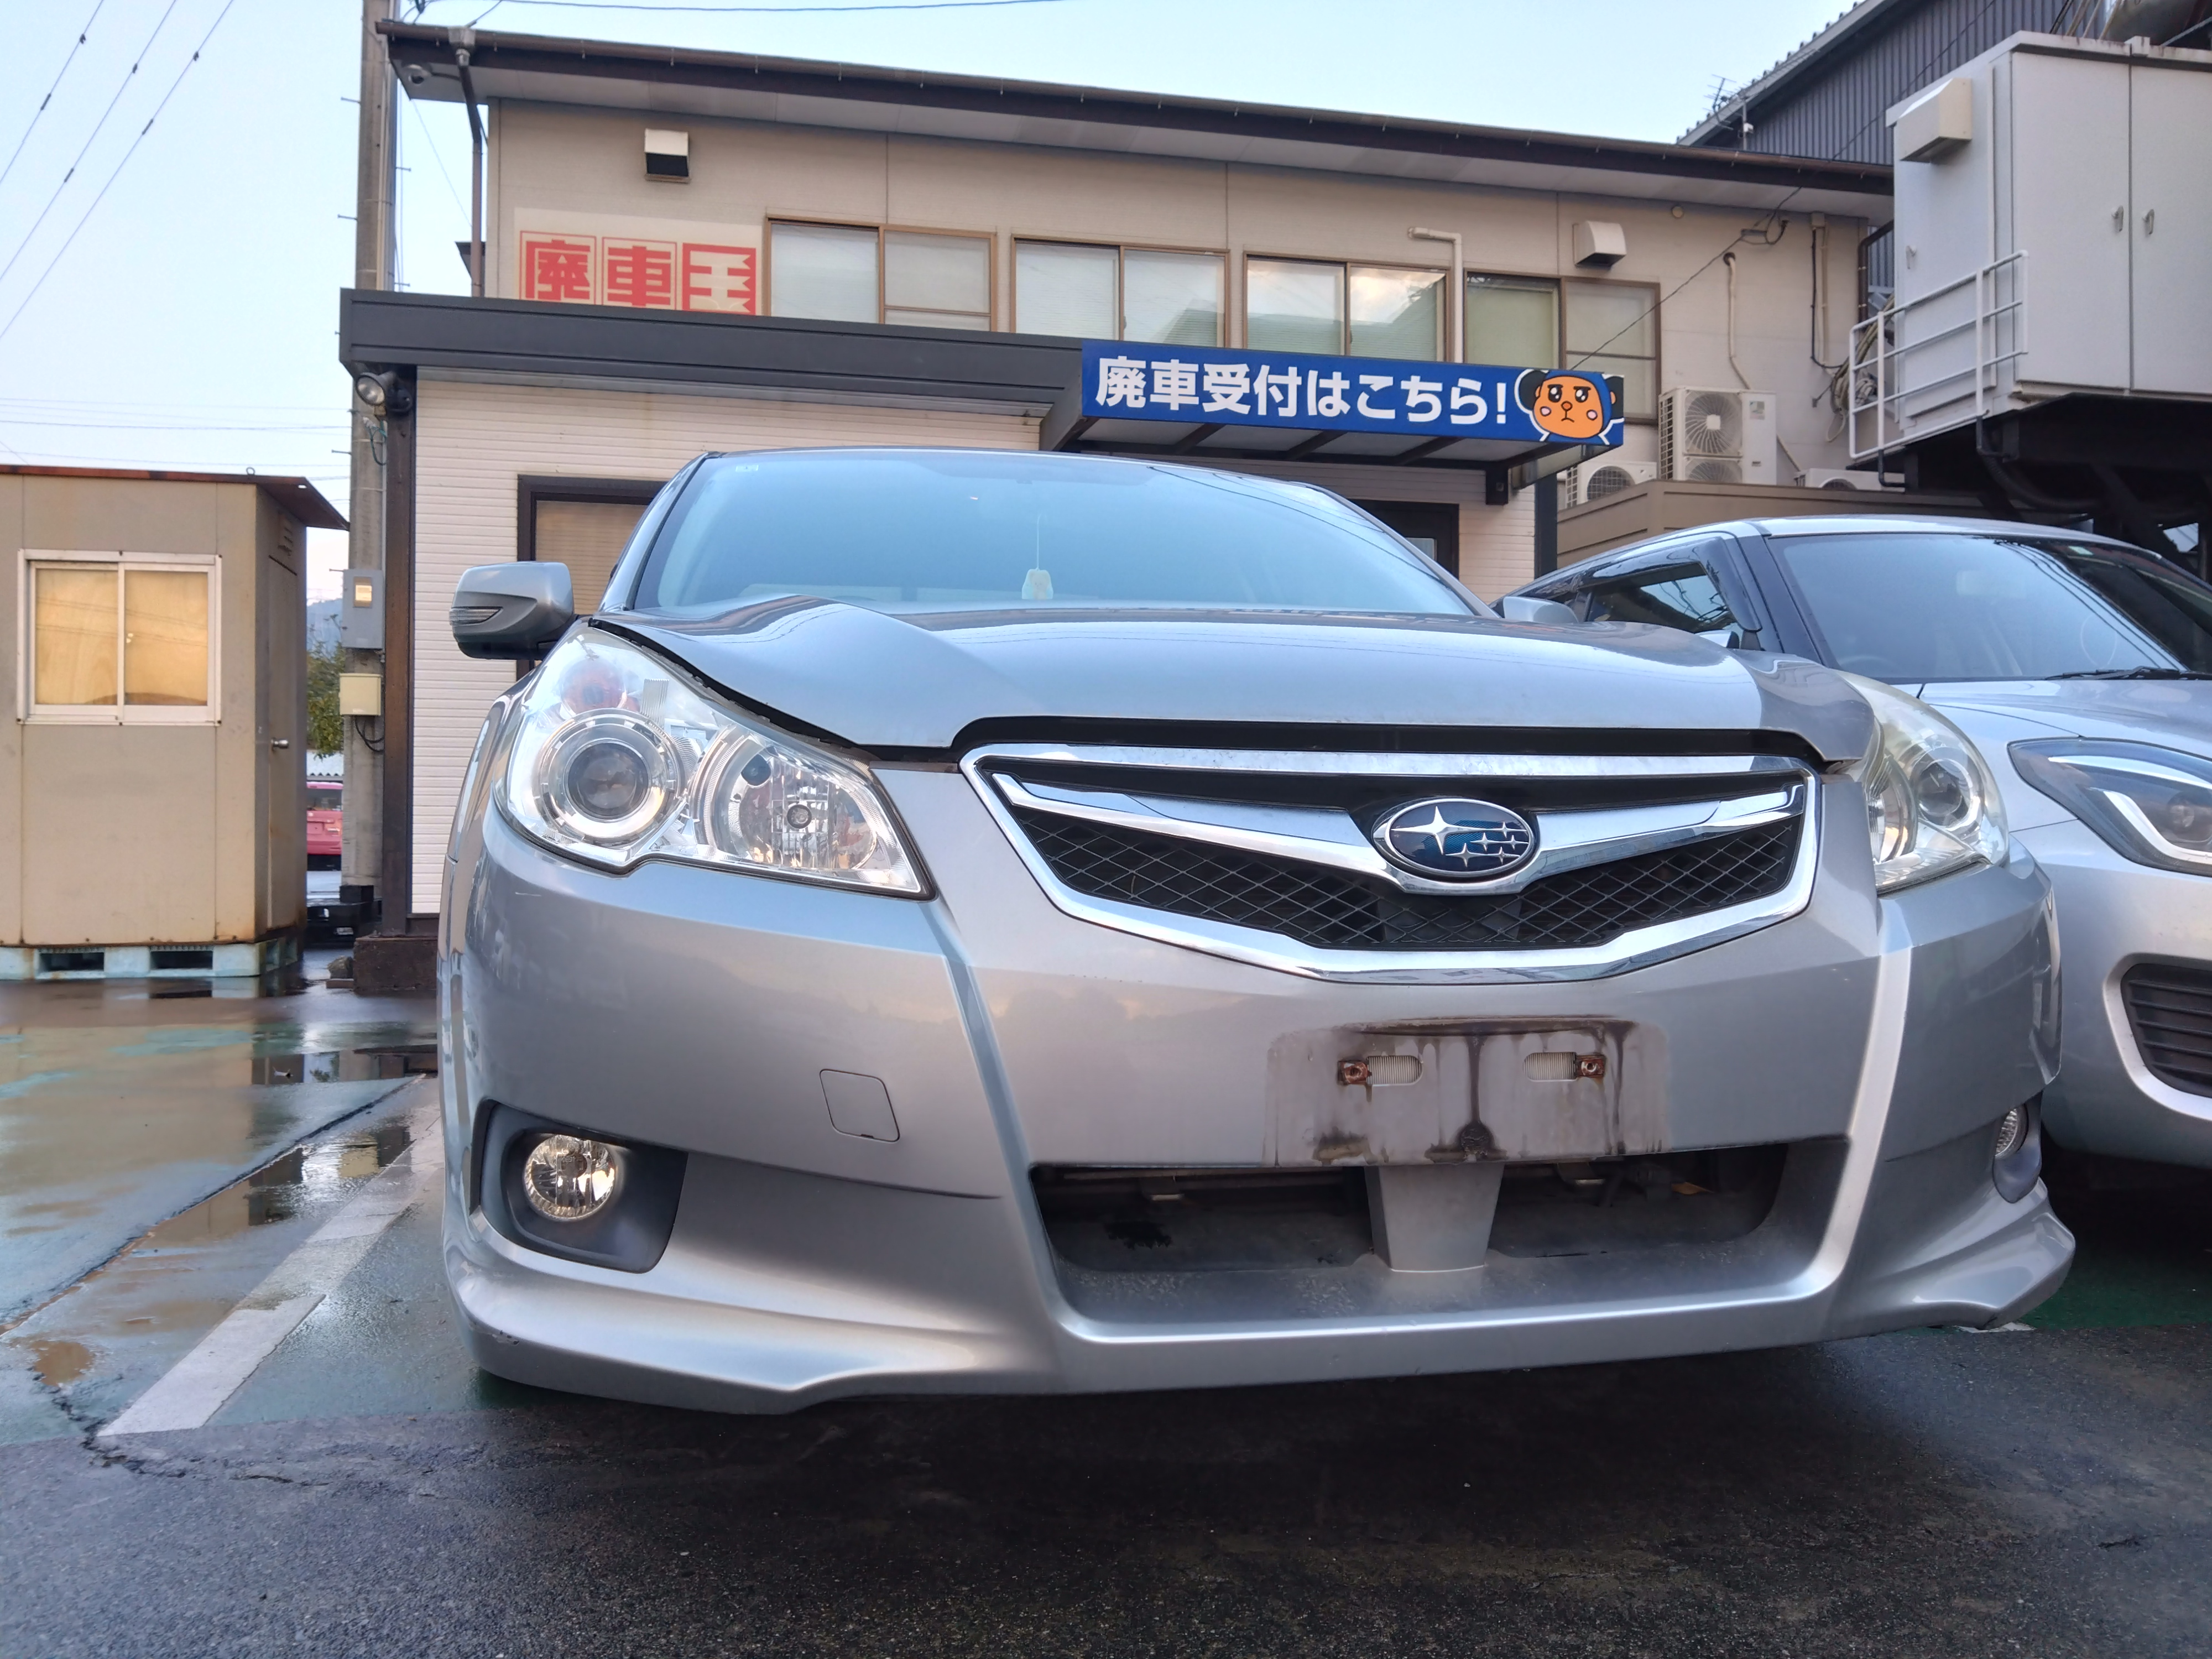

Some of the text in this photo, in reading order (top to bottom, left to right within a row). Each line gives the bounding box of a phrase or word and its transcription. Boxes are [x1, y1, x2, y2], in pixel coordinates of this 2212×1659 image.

[525, 239, 756, 315] 廃車王
[1095, 356, 1506, 425] 廃車受付はこちら!
